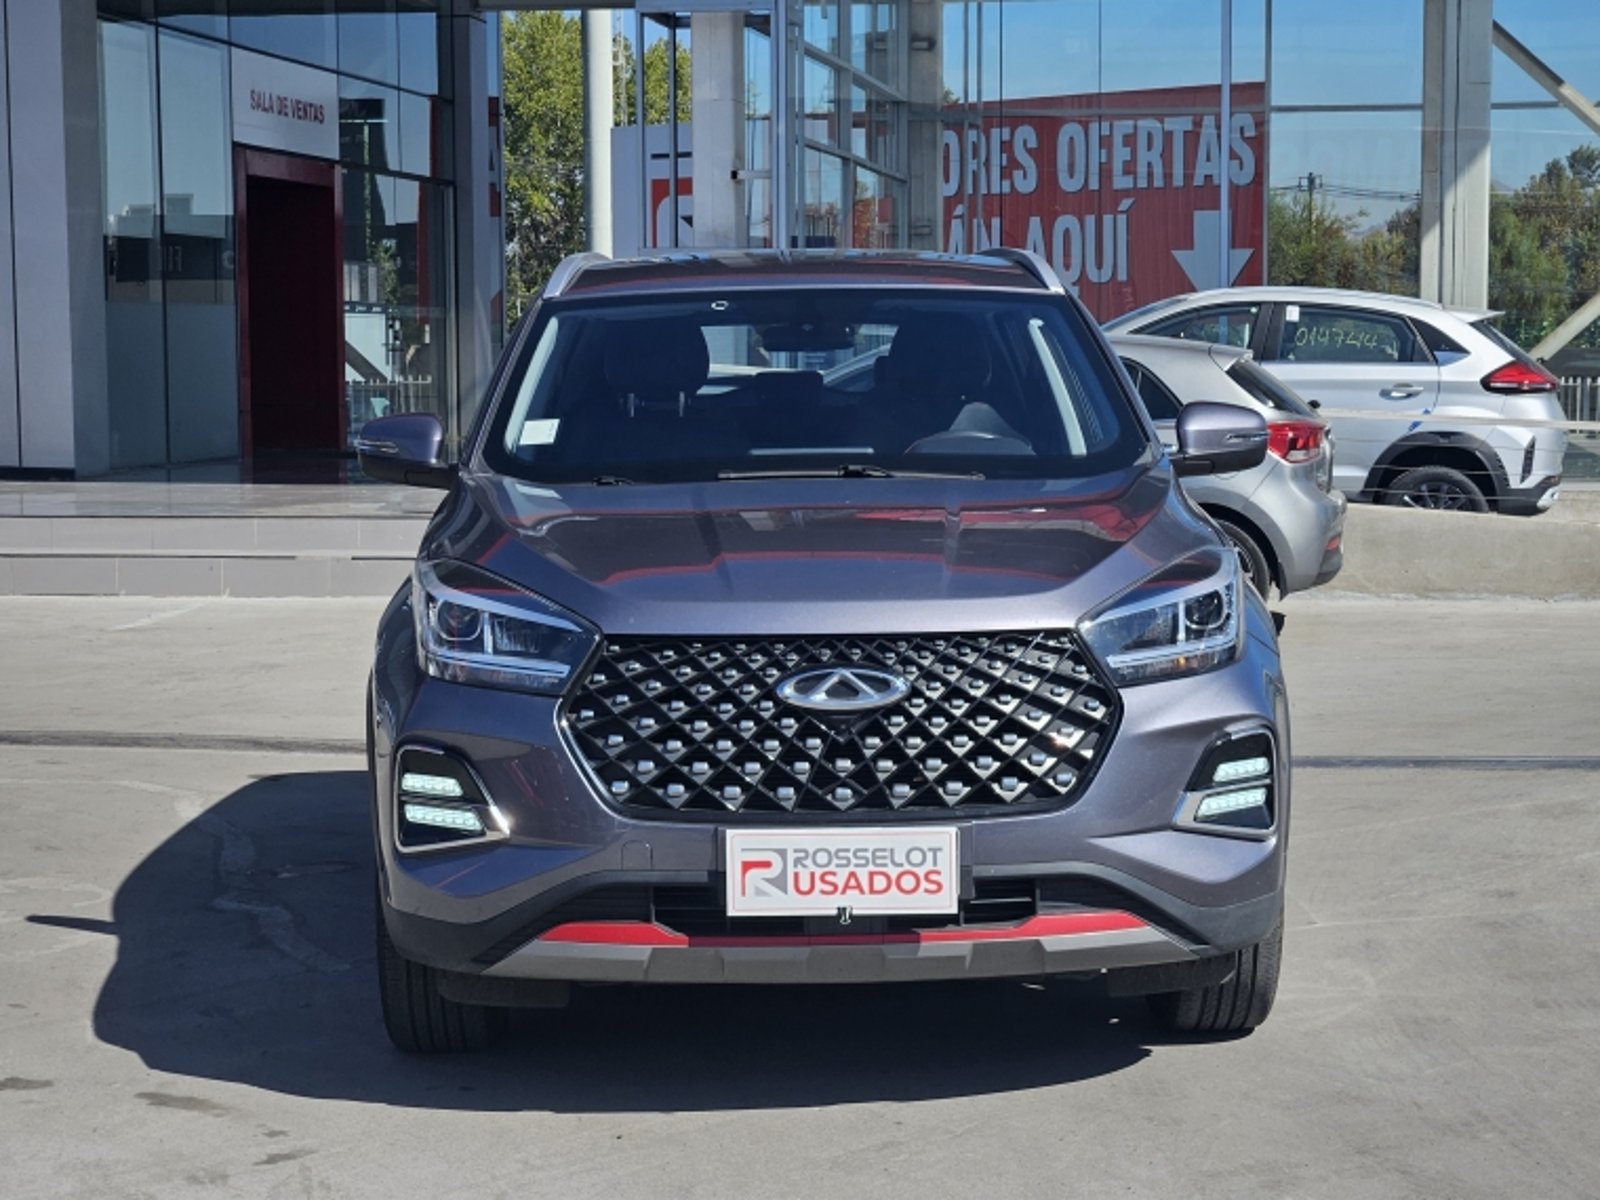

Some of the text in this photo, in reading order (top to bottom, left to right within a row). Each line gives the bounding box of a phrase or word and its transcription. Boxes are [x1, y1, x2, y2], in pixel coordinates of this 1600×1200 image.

[250, 89, 325, 124] SALA DE VENTAS
[1056, 113, 1256, 193] OFERTAS
[793, 847, 943, 868] ROSSELOT
[793, 870, 944, 896] USADOS
